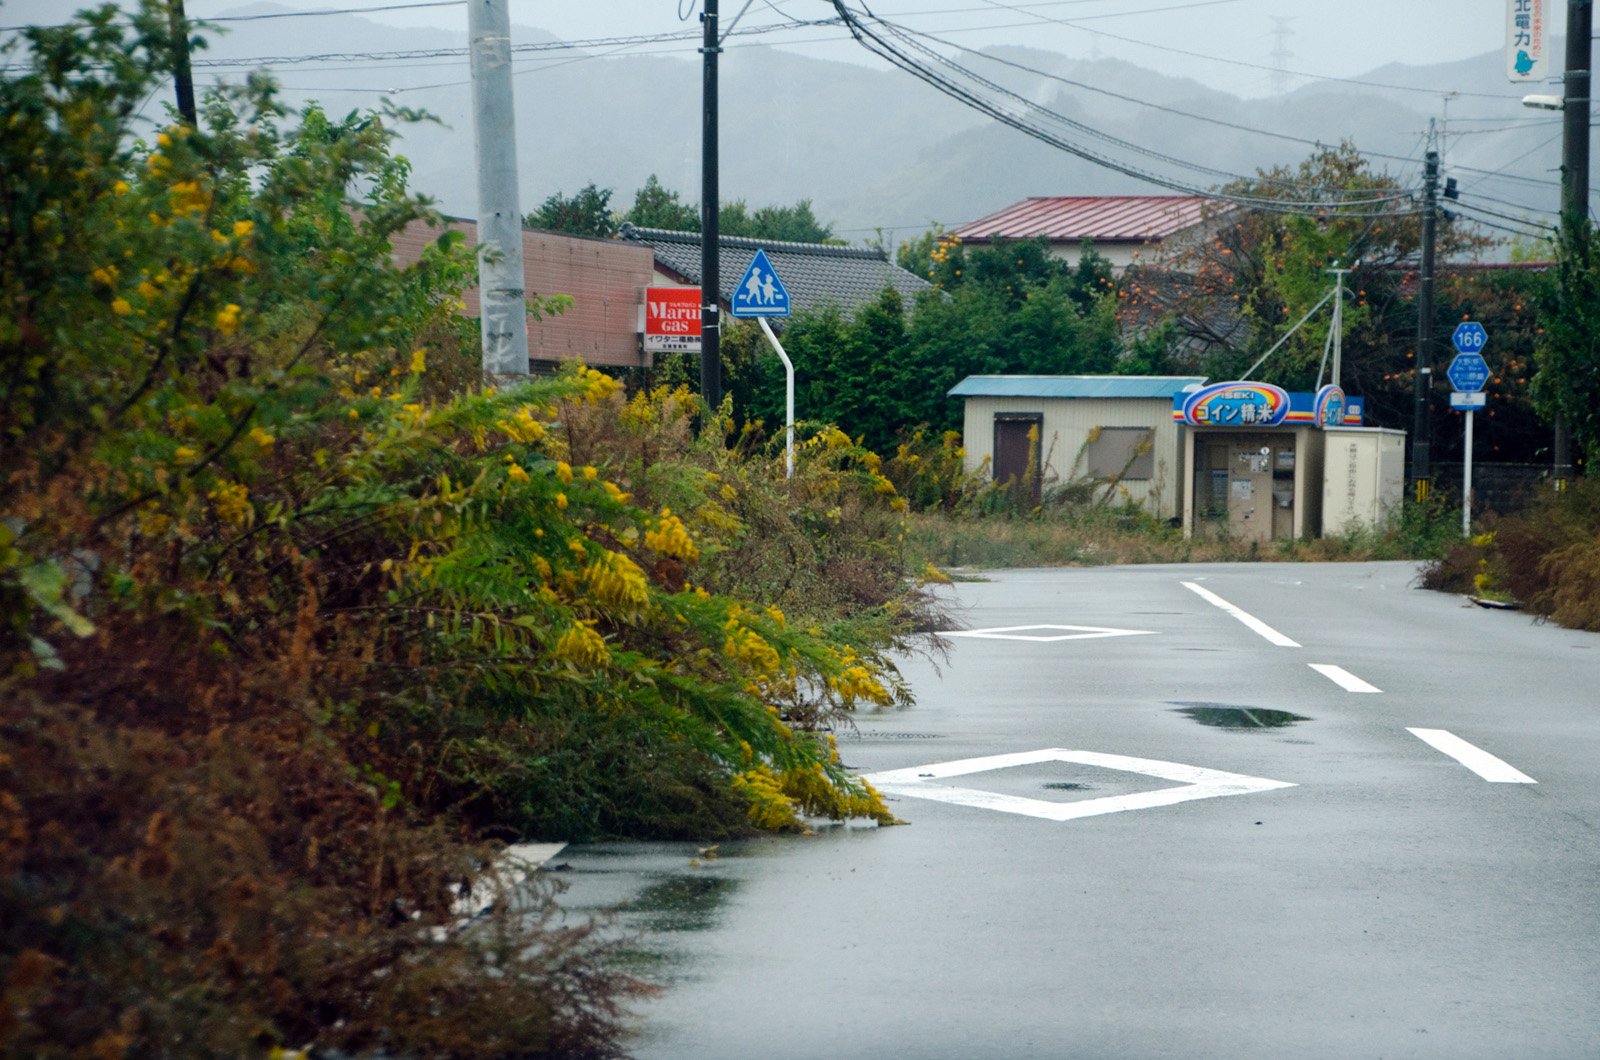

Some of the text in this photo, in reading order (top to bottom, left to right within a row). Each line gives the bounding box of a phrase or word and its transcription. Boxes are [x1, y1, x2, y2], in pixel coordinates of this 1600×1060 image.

[647, 302, 702, 319] Marui
[1458, 332, 1482, 347] 166
[1197, 402, 1274, 423] コイン精米
